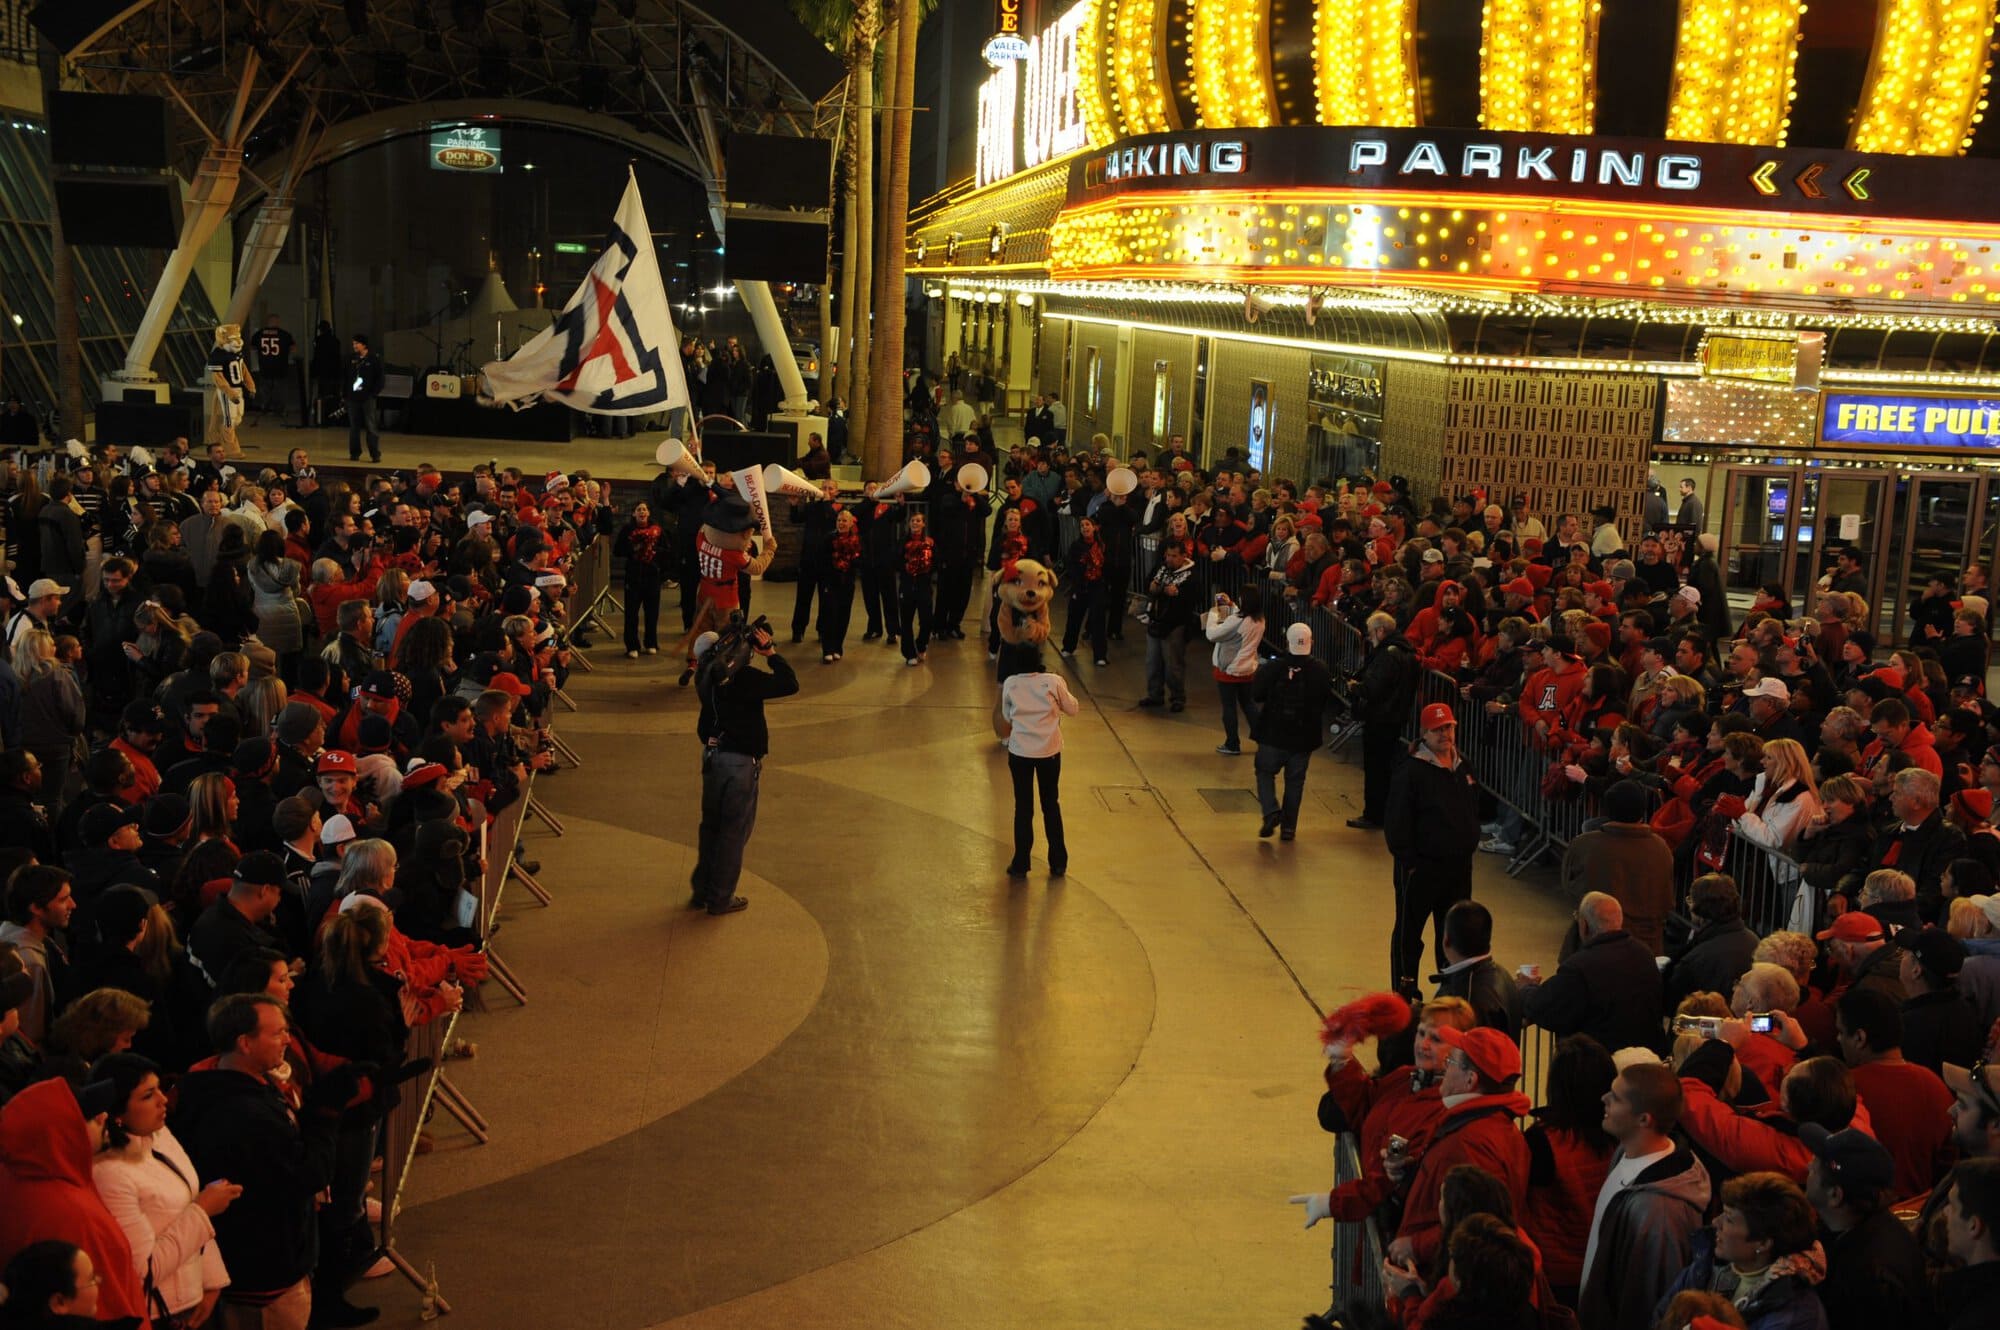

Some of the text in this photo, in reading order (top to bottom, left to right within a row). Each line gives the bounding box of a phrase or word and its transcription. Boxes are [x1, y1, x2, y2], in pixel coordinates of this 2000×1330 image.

[993, 41, 1024, 51] VALET
[447, 138, 487, 149] PARKING
[446, 151, 470, 161] DON
[1349, 139, 1702, 189] PARKING
[260, 337, 280, 356] 55
[1837, 403, 1918, 433] FREE
[1537, 684, 1558, 711] A
